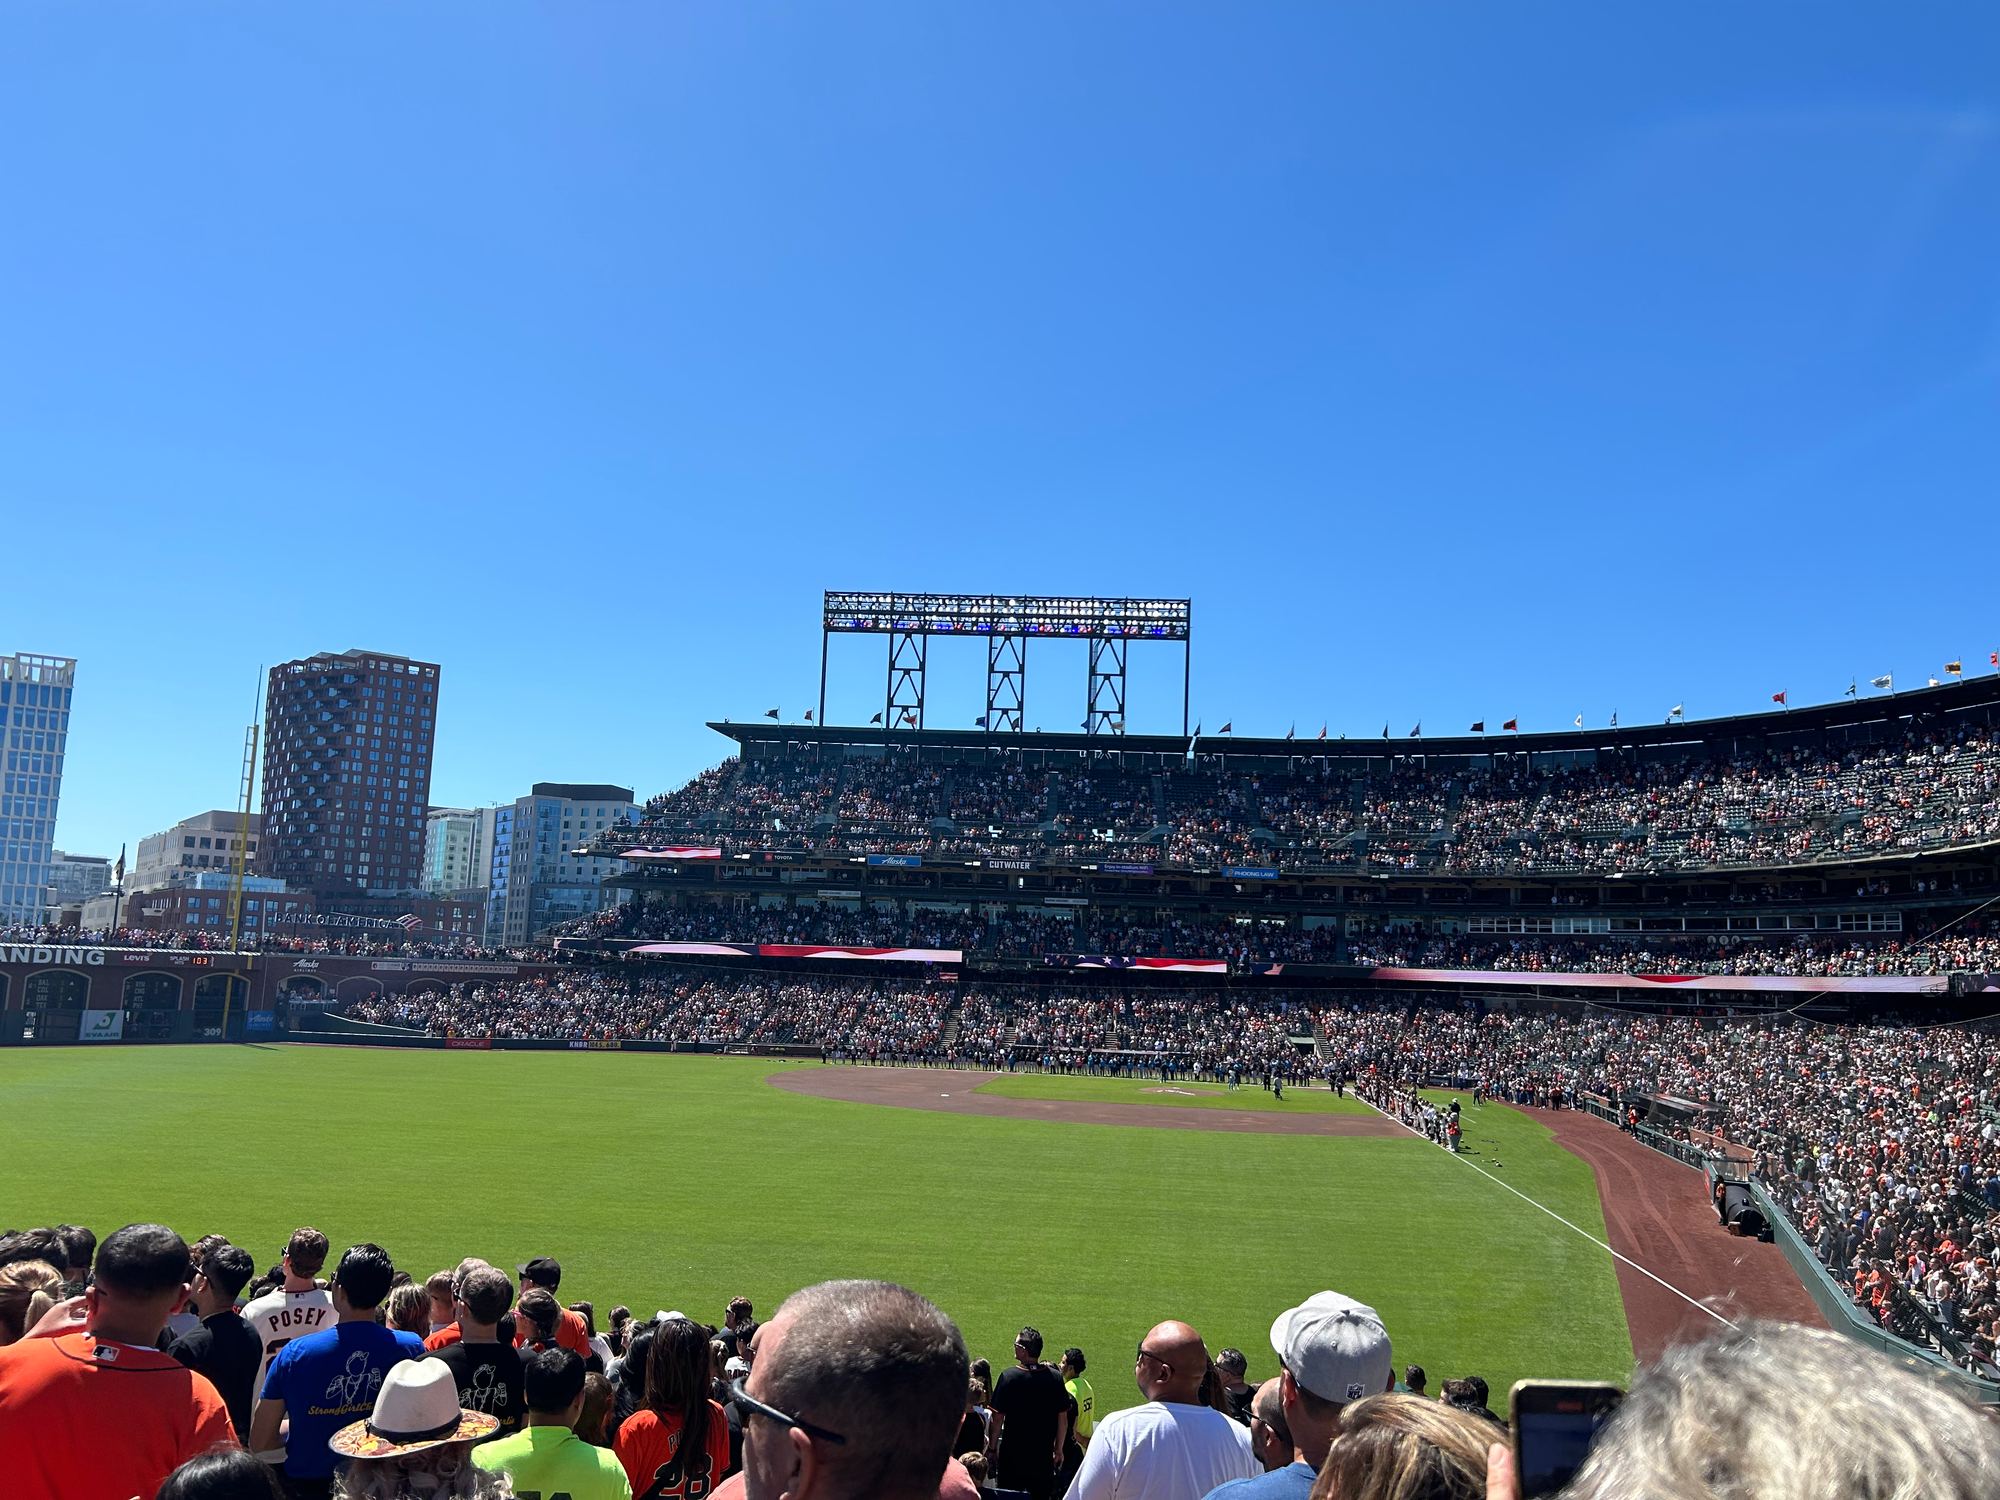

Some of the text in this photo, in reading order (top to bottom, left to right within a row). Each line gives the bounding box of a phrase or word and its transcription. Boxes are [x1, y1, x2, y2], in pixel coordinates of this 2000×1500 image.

[881, 856, 907, 865] Alaska
[989, 860, 1031, 870] CUTWATER
[274, 911, 312, 925] BANK
[335, 914, 395, 929] AMERICA
[192, 957, 208, 965] 103
[293, 958, 320, 968] Alaska
[204, 1027, 222, 1037] 309
[268, 1307, 327, 1332] POSEY
